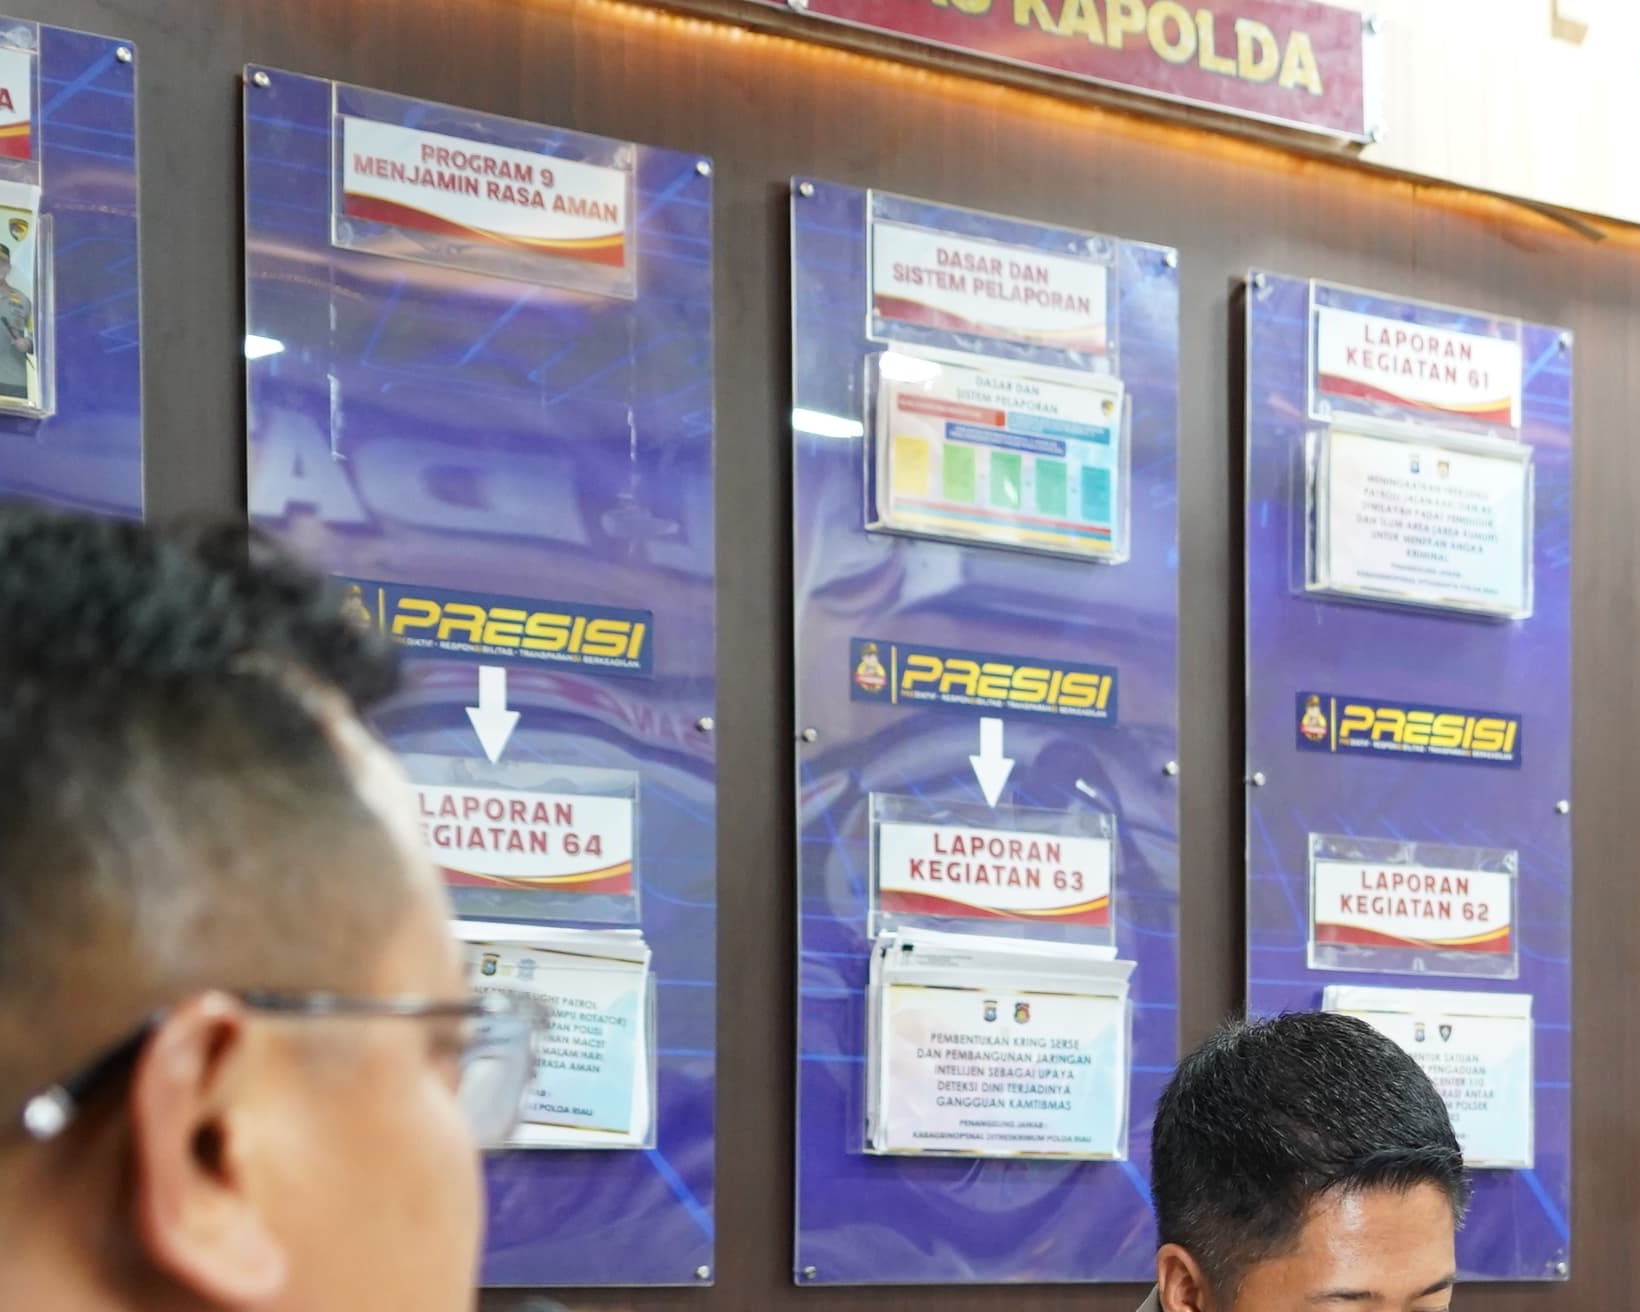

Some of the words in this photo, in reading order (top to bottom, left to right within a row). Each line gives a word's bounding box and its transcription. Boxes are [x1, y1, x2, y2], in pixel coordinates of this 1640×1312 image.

[1013, 0, 1324, 96] KAPOLDA
[420, 143, 532, 182] PROGRAM
[539, 167, 554, 188] 9
[353, 153, 479, 197] MENJAMIN
[487, 180, 545, 209] RASA
[552, 194, 618, 223] AMAN
[936, 248, 1001, 276] DASAR
[1009, 261, 1049, 285] DAN
[892, 262, 966, 293] SISTEM
[973, 278, 1090, 315] PELAPORAN
[1364, 324, 1472, 361] LAPORAN
[1346, 346, 1457, 384] KEGIATAN
[1468, 368, 1489, 388] 61
[391, 597, 647, 659] PRESISI
[901, 654, 1112, 710] PRESISI
[1339, 704, 1518, 753] PRESISI
[418, 792, 573, 826] LAPORAN
[421, 823, 549, 856] EGIATAN
[562, 833, 603, 857] 64
[933, 833, 1062, 864] LAPORAN
[909, 858, 1041, 888] KEGIATAN
[1053, 871, 1084, 891] 63
[1361, 870, 1469, 896] LAPORAN
[1340, 894, 1452, 920] KEGIATAN
[1462, 902, 1490, 921] 62
[916, 1048, 942, 1059] DAN
[945, 1049, 1032, 1064] PEMBANGUNAN
[1036, 1053, 1092, 1065] JARINGAN
[930, 1032, 1009, 1047] PEMBENTUKAN
[1012, 1036, 1047, 1048] KRING
[1050, 1038, 1080, 1050] SERSE
[937, 1081, 978, 1093] DETEKSI
[1007, 1083, 1072, 1095] TERJADINYA
[1038, 1068, 1075, 1080] UPAYA
[936, 1096, 1005, 1109] GANGGUAN
[1009, 1098, 1072, 1111] KAMTIBMAS
